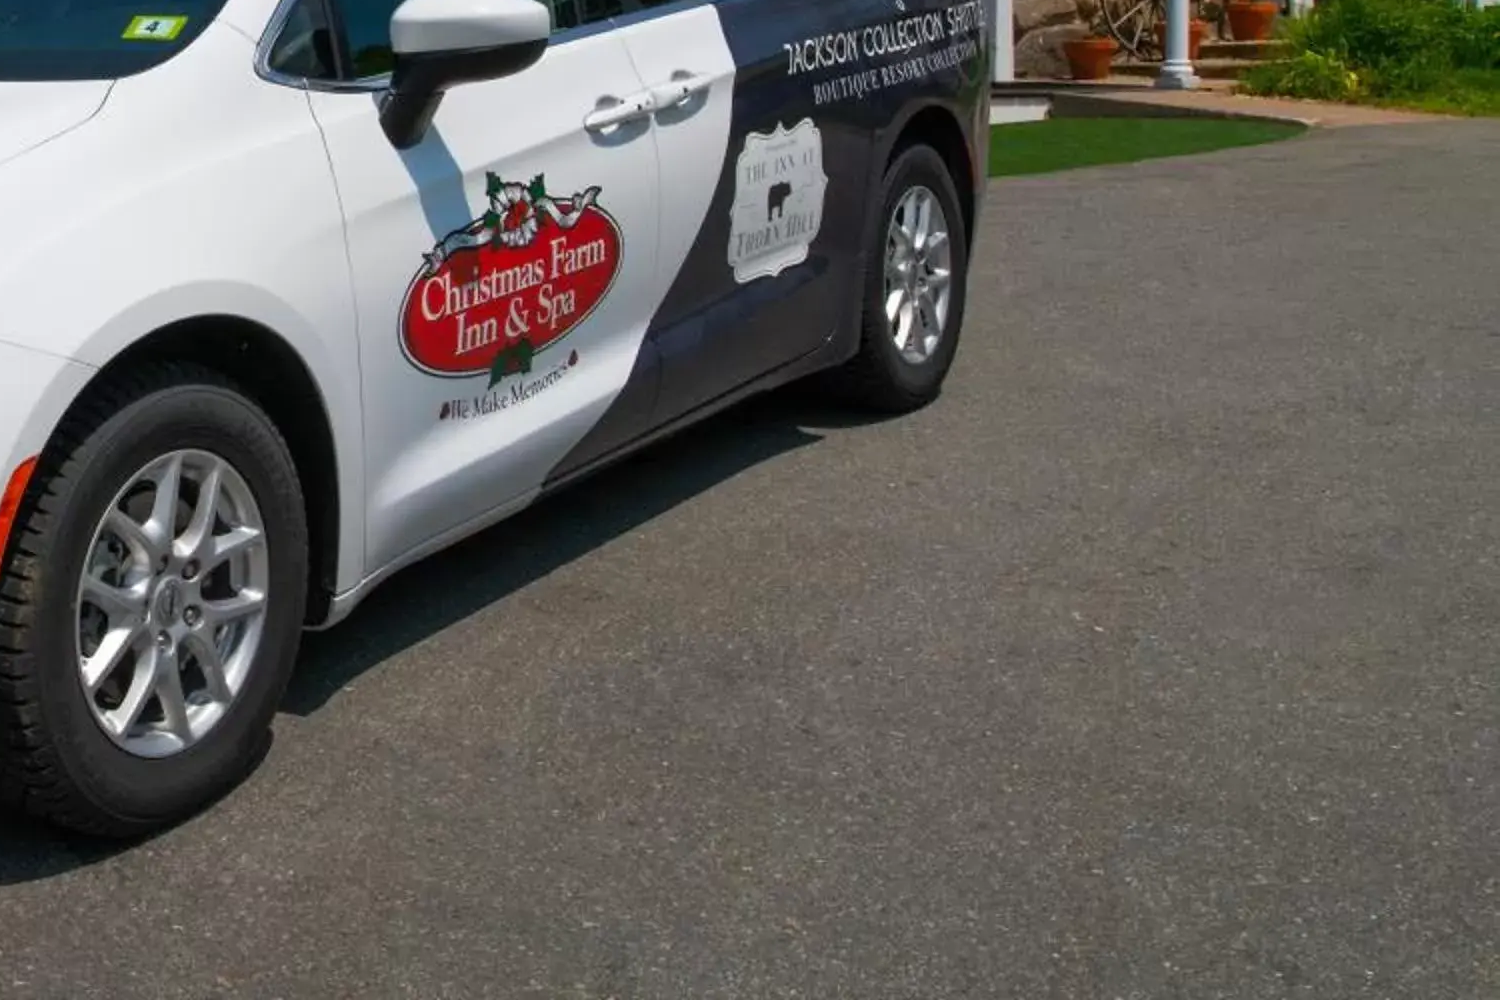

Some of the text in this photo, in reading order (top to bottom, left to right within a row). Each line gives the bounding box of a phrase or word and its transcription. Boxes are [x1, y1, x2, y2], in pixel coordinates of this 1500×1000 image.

[144, 20, 162, 34] 4
[784, 32, 858, 75] JACKSON
[863, 11, 946, 56] COLLECTION
[813, 69, 881, 105] BOUTIQUE
[880, 56, 928, 87] RESORT
[774, 153, 796, 176] INN
[420, 236, 606, 322] Christmas Farm
[454, 283, 576, 356] Inn & Spa
[451, 361, 569, 420] We Make Memories
